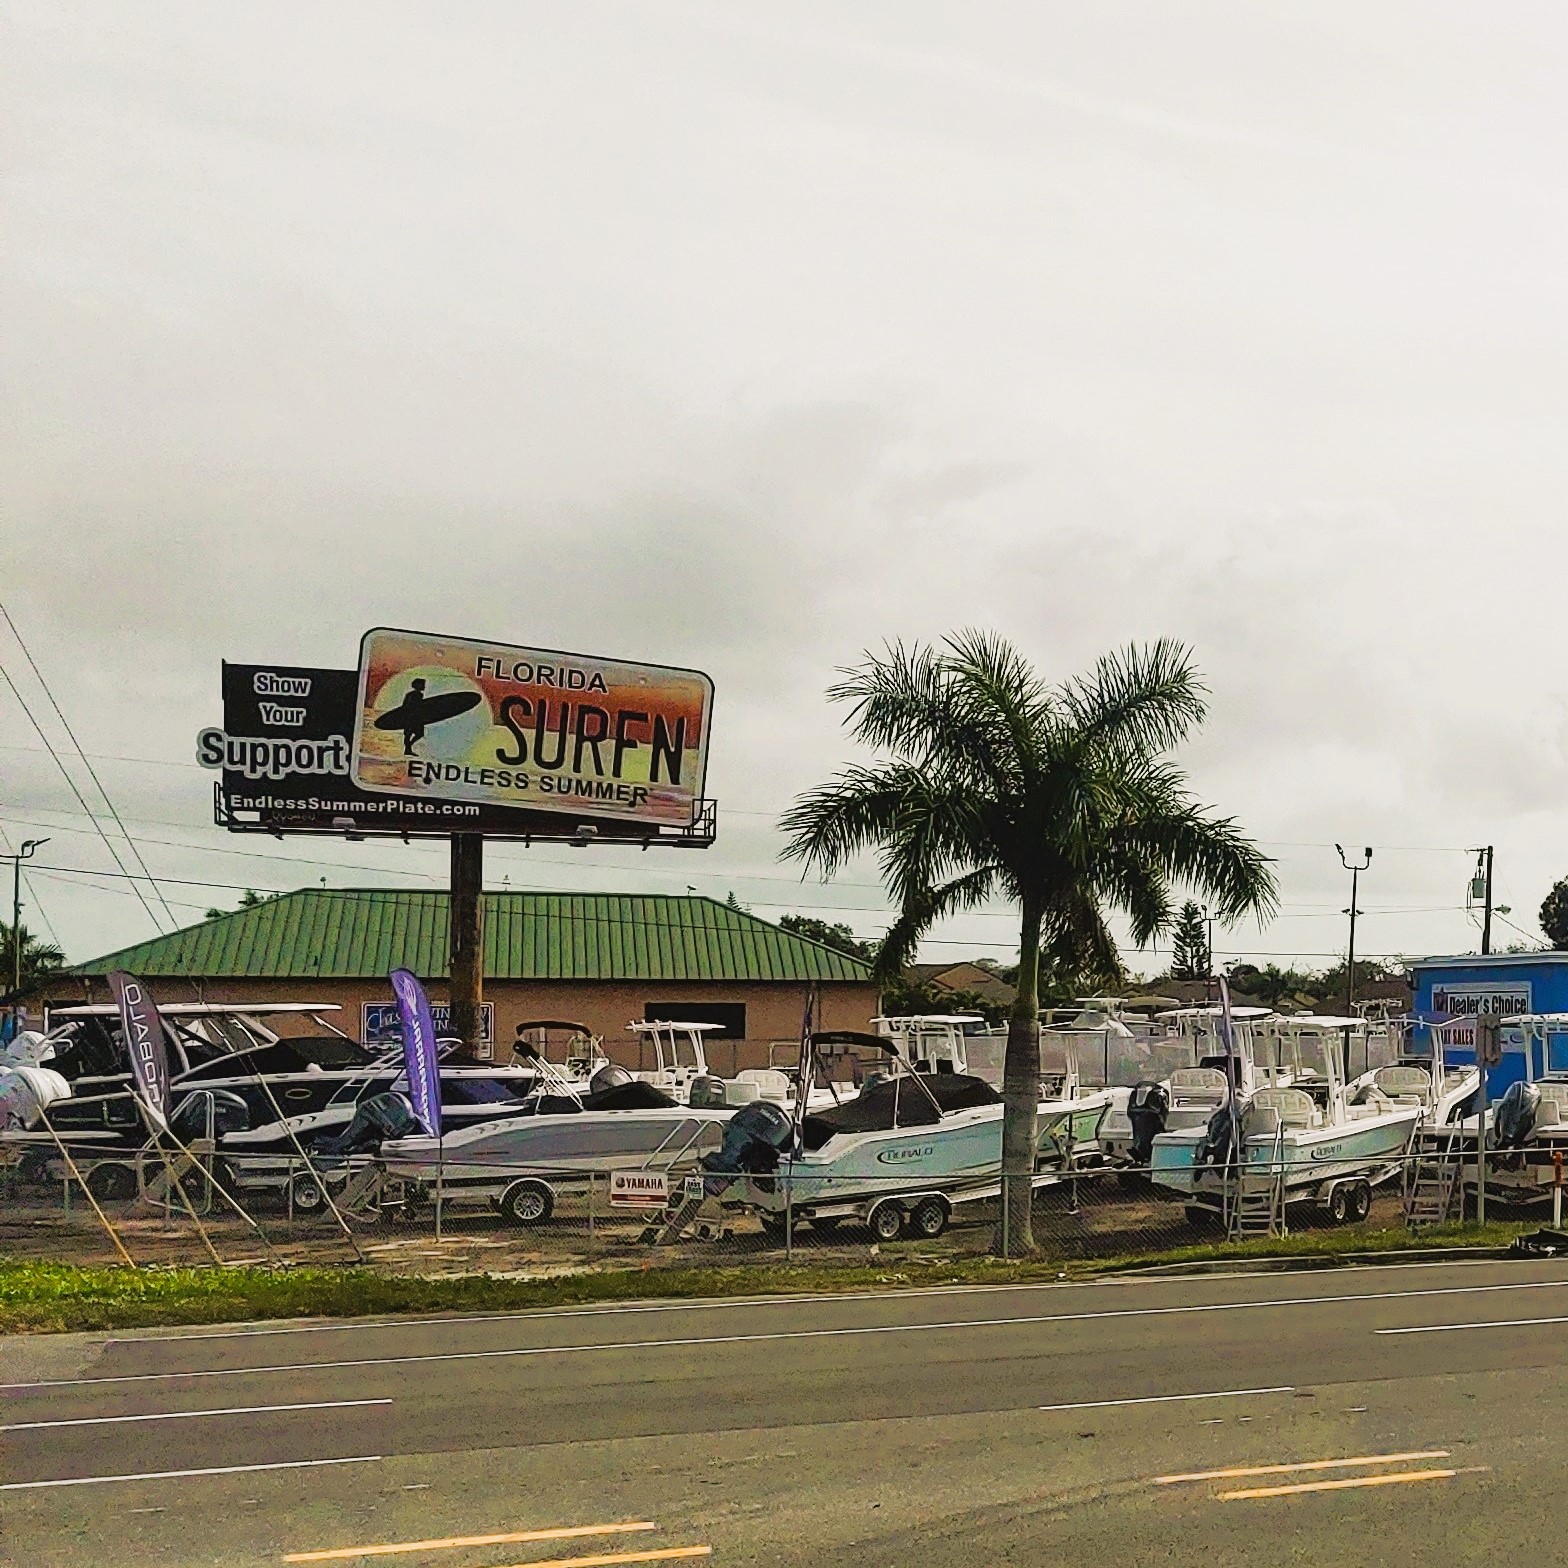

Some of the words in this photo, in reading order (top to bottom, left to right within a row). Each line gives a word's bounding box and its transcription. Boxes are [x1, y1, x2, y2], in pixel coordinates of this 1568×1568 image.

[255, 673, 310, 696] Show
[475, 656, 609, 694] FLORIDA
[260, 704, 305, 725] Your
[495, 694, 689, 786] SURFN
[200, 731, 347, 775] Support
[407, 760, 530, 790] ENDLESS
[539, 775, 650, 806] SUMMER
[230, 794, 480, 816] EndlessSummerPlate.com
[1449, 995, 1490, 1015] Dealer's
[1491, 994, 1527, 1015] Choice
[1452, 1028, 1474, 1046] SALES
[626, 1177, 664, 1190] YAMAHA
